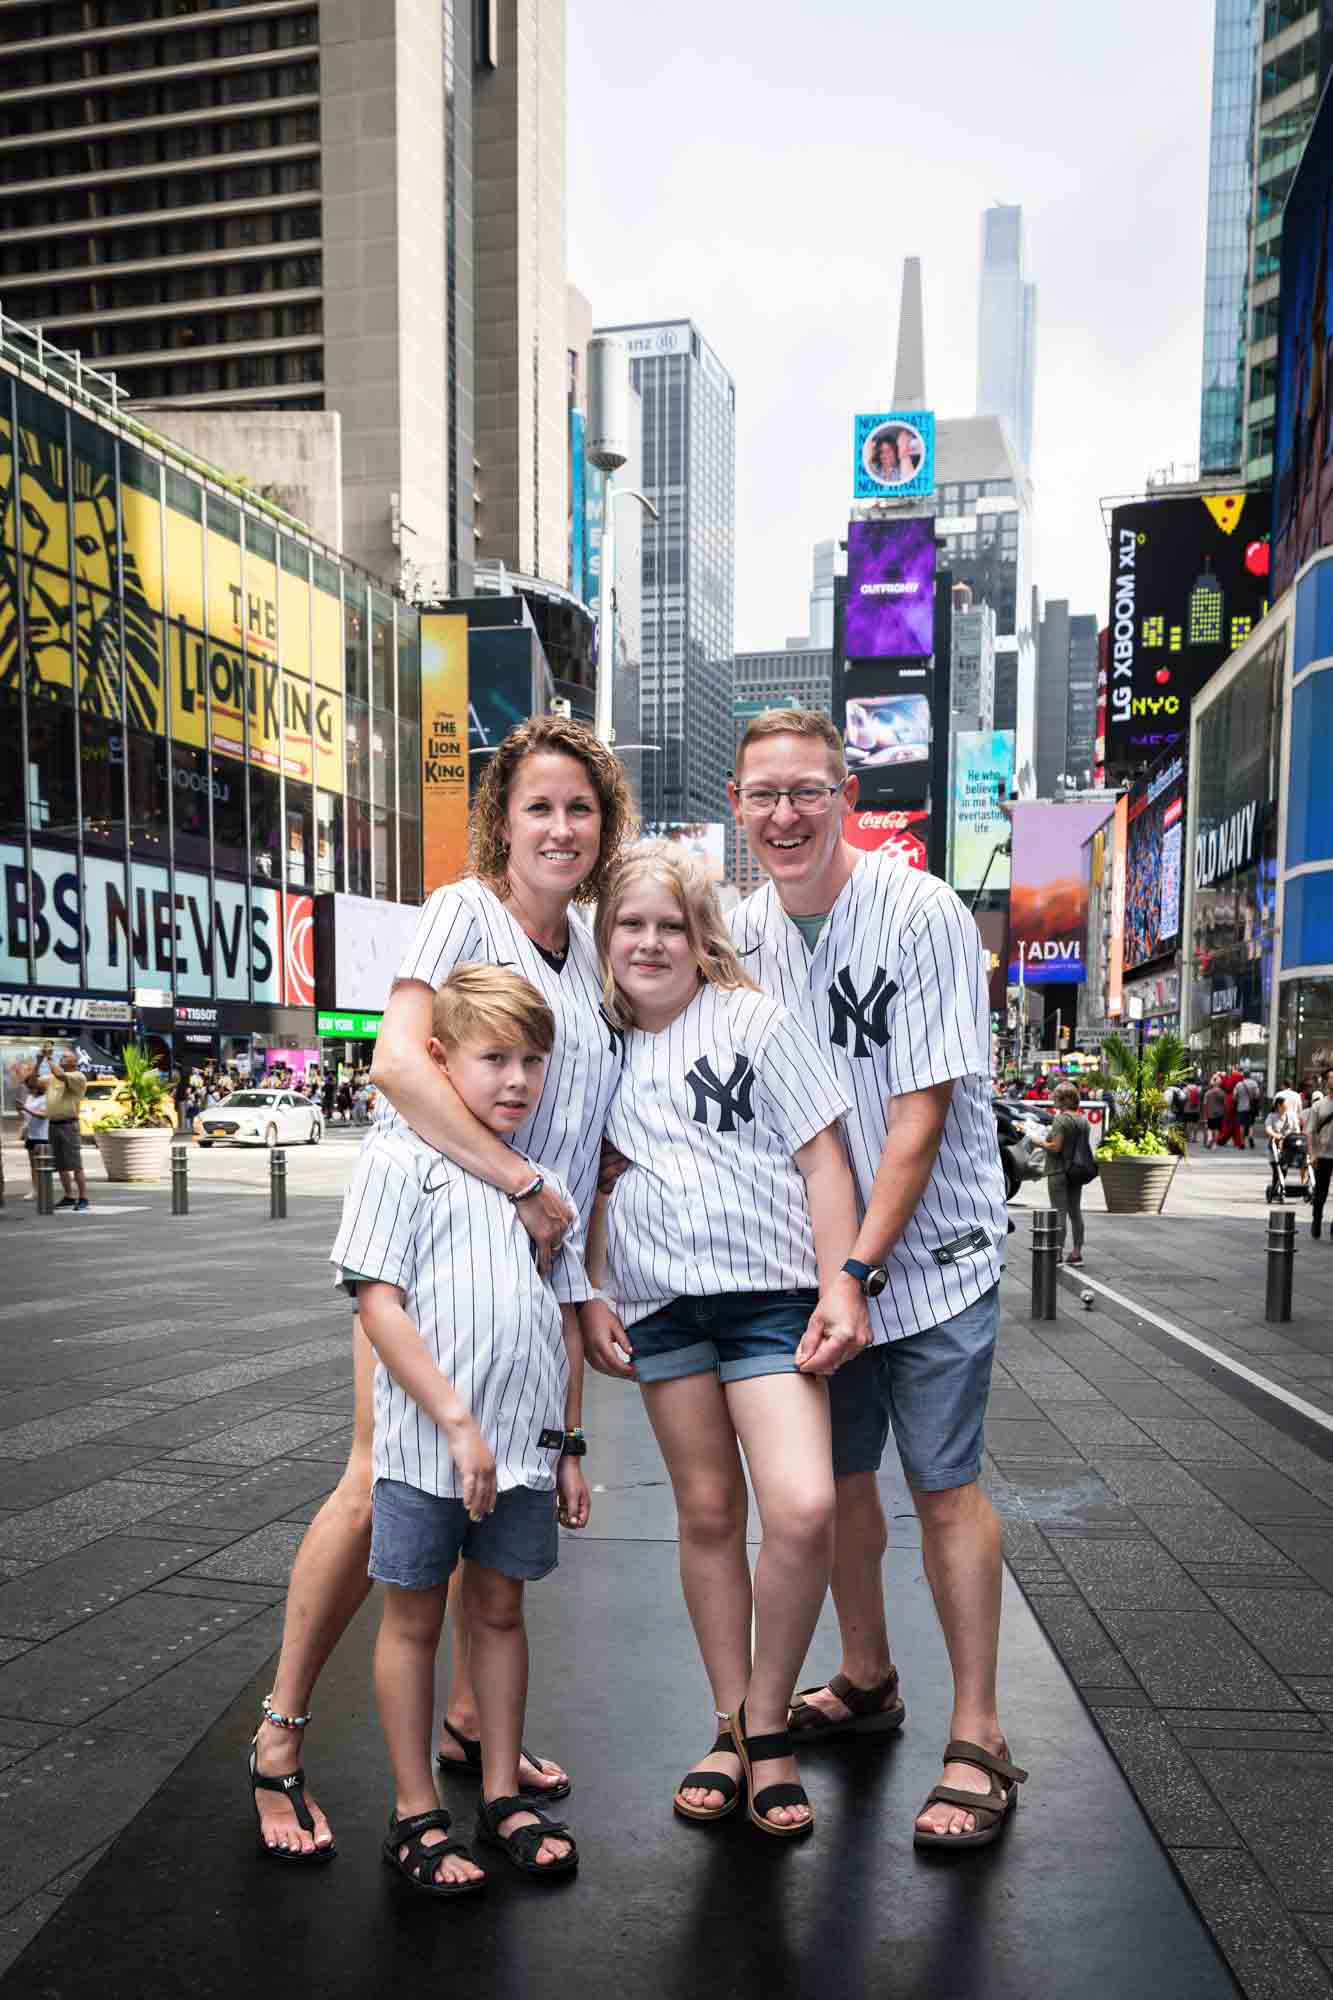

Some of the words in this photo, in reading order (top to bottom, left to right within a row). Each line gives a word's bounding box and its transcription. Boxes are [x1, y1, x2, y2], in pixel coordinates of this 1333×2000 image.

[1119, 528, 1137, 569] XL7
[229, 583, 277, 641] THE
[1113, 574, 1136, 679] XBOOM
[1111, 685, 1132, 722] LG
[1131, 695, 1180, 716] NYC
[432, 721, 457, 733] THE
[967, 769, 980, 781] He
[1194, 831, 1217, 889] OLD
[1217, 800, 1257, 878] NAVY
[0, 863, 91, 966] BS
[105, 881, 273, 984] NEWS
[187, 1008, 218, 1021] TISSOT
